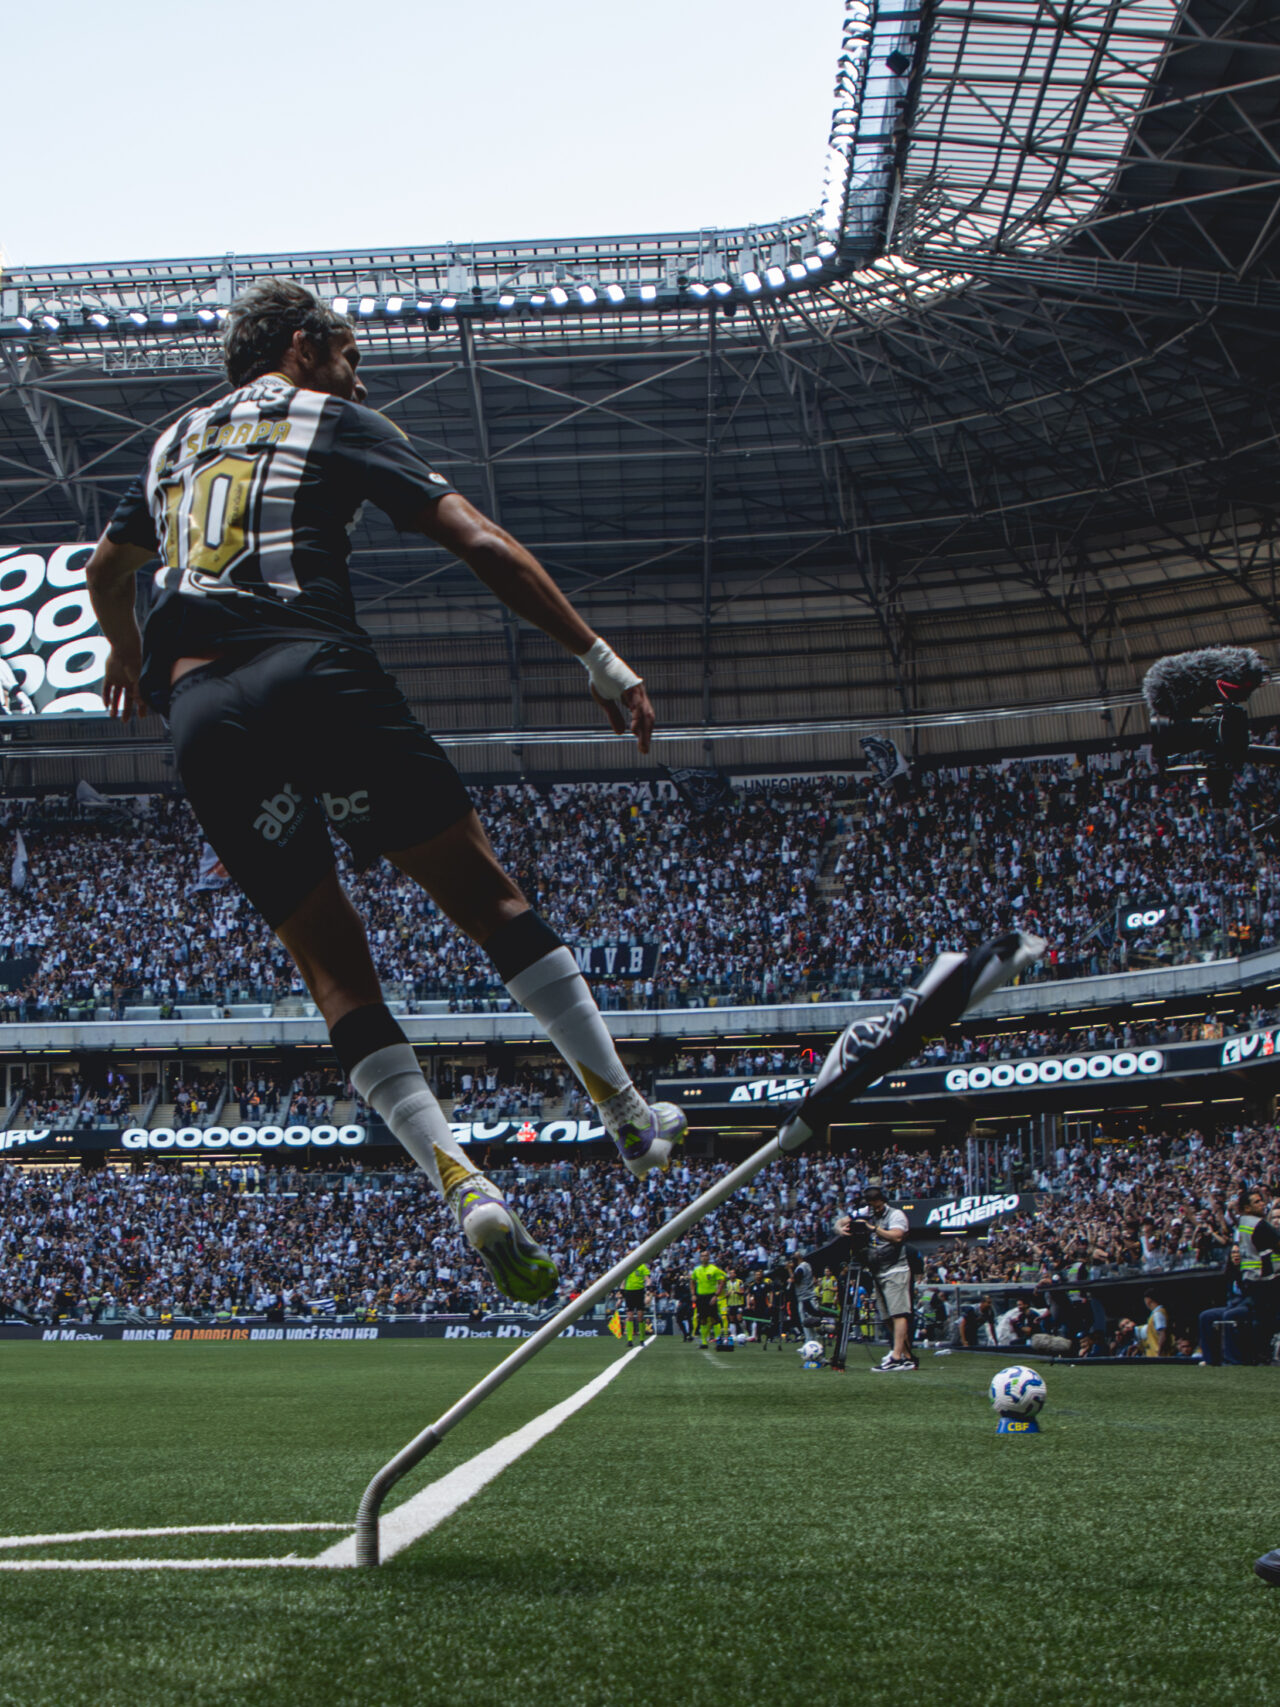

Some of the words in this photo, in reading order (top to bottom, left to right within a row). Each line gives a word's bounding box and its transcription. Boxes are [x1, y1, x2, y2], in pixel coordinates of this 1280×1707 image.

[186, 420, 292, 457] SCARPA
[158, 452, 268, 578] 10
[945, 1050, 1164, 1091] GOOOOOOOO
[122, 1125, 366, 1148] GOOOOOOOO
[122, 1329, 155, 1341] MAIS
[1007, 1422, 1030, 1432] CBF
